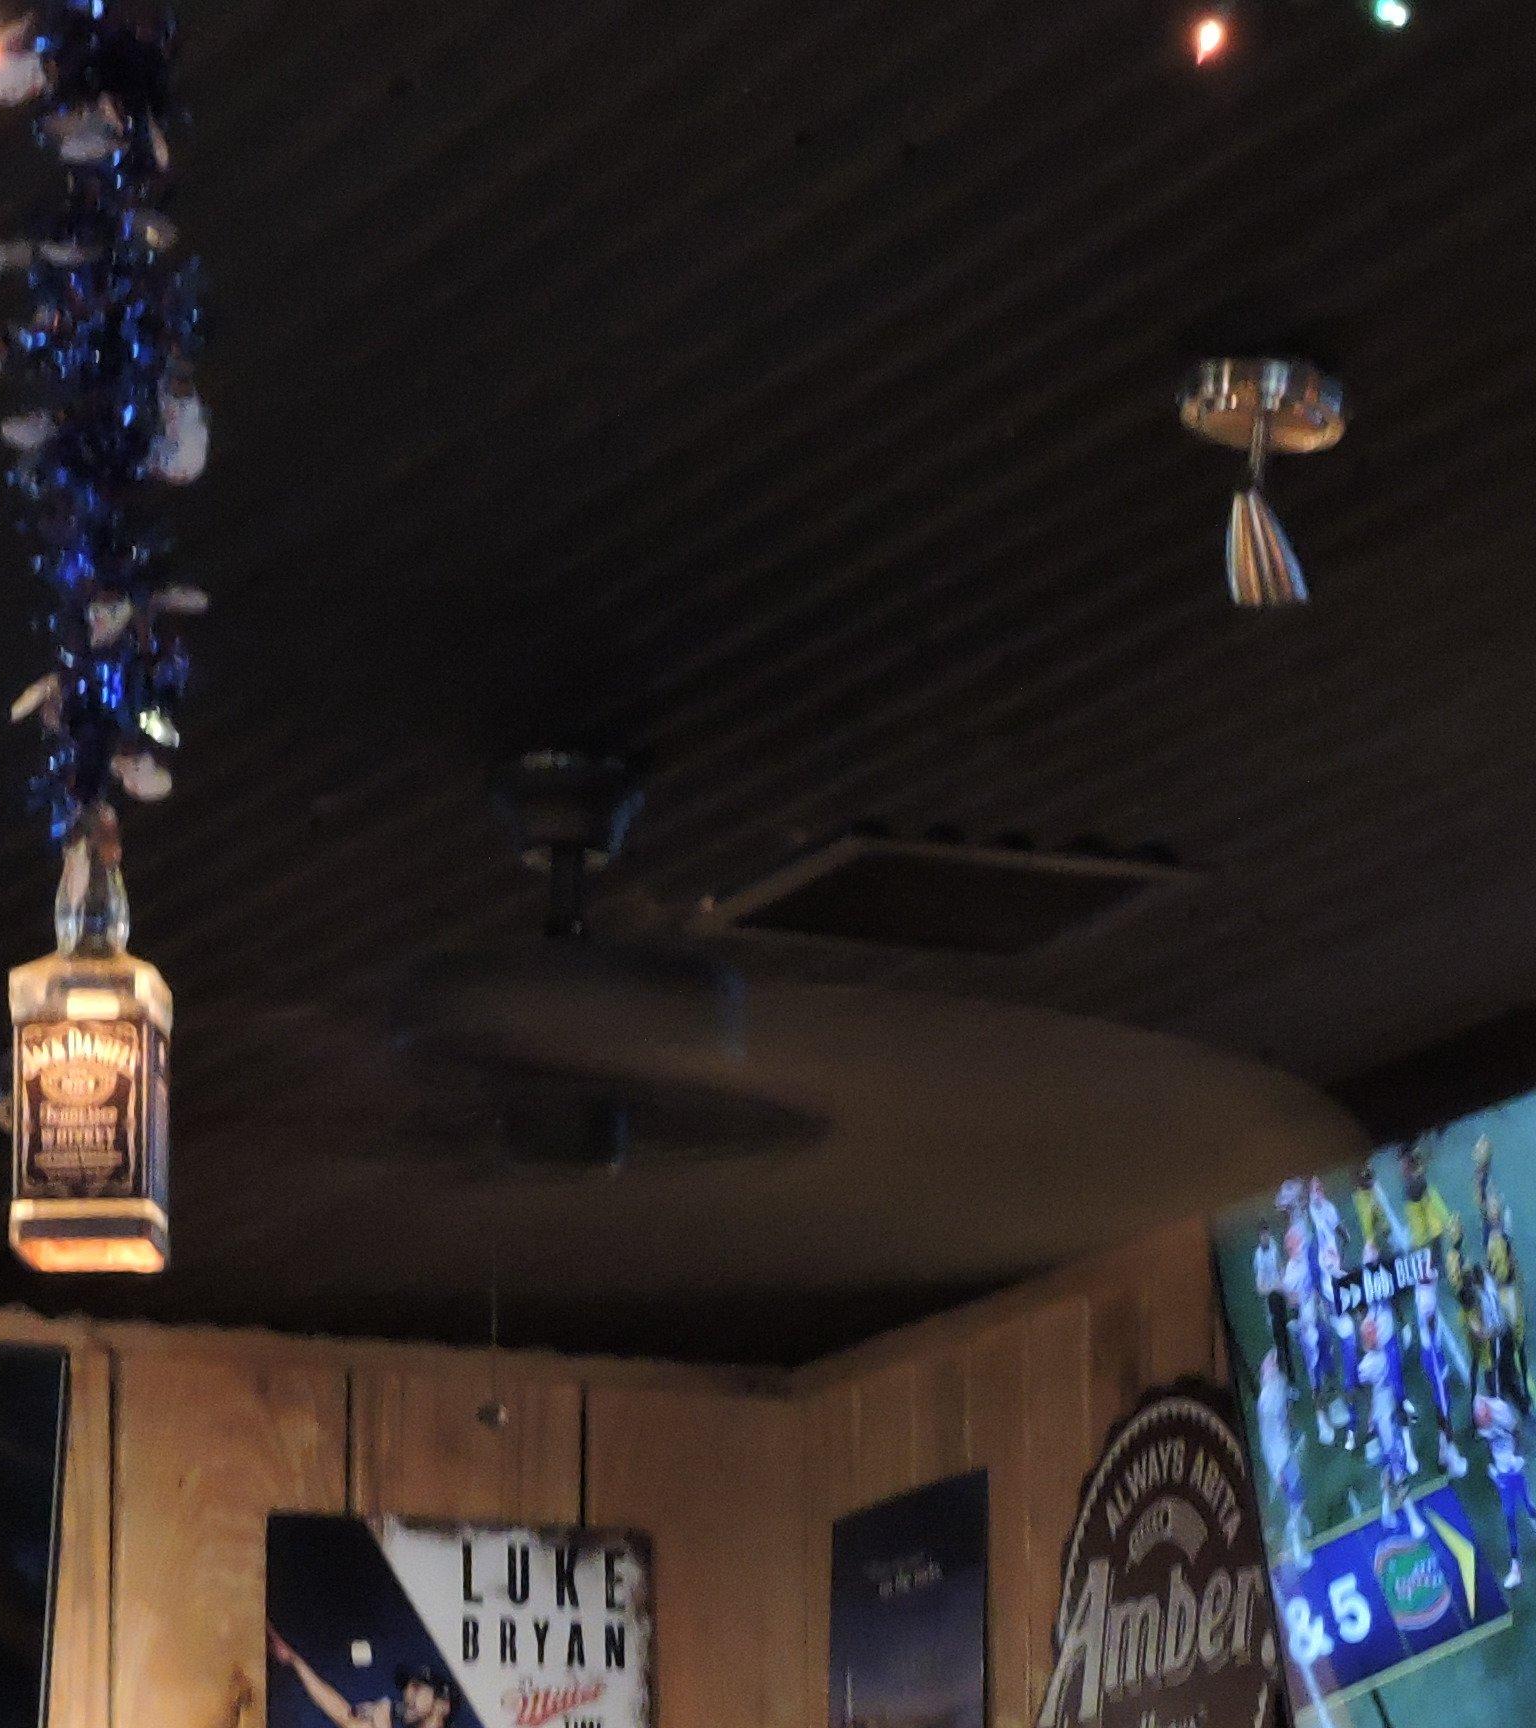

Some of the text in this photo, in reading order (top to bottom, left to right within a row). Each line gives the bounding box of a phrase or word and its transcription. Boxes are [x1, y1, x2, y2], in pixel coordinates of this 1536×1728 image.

[463, 1540, 628, 1612] LUKE
[1328, 1572, 1372, 1644] 5
[462, 1617, 627, 1670] BRYAN
